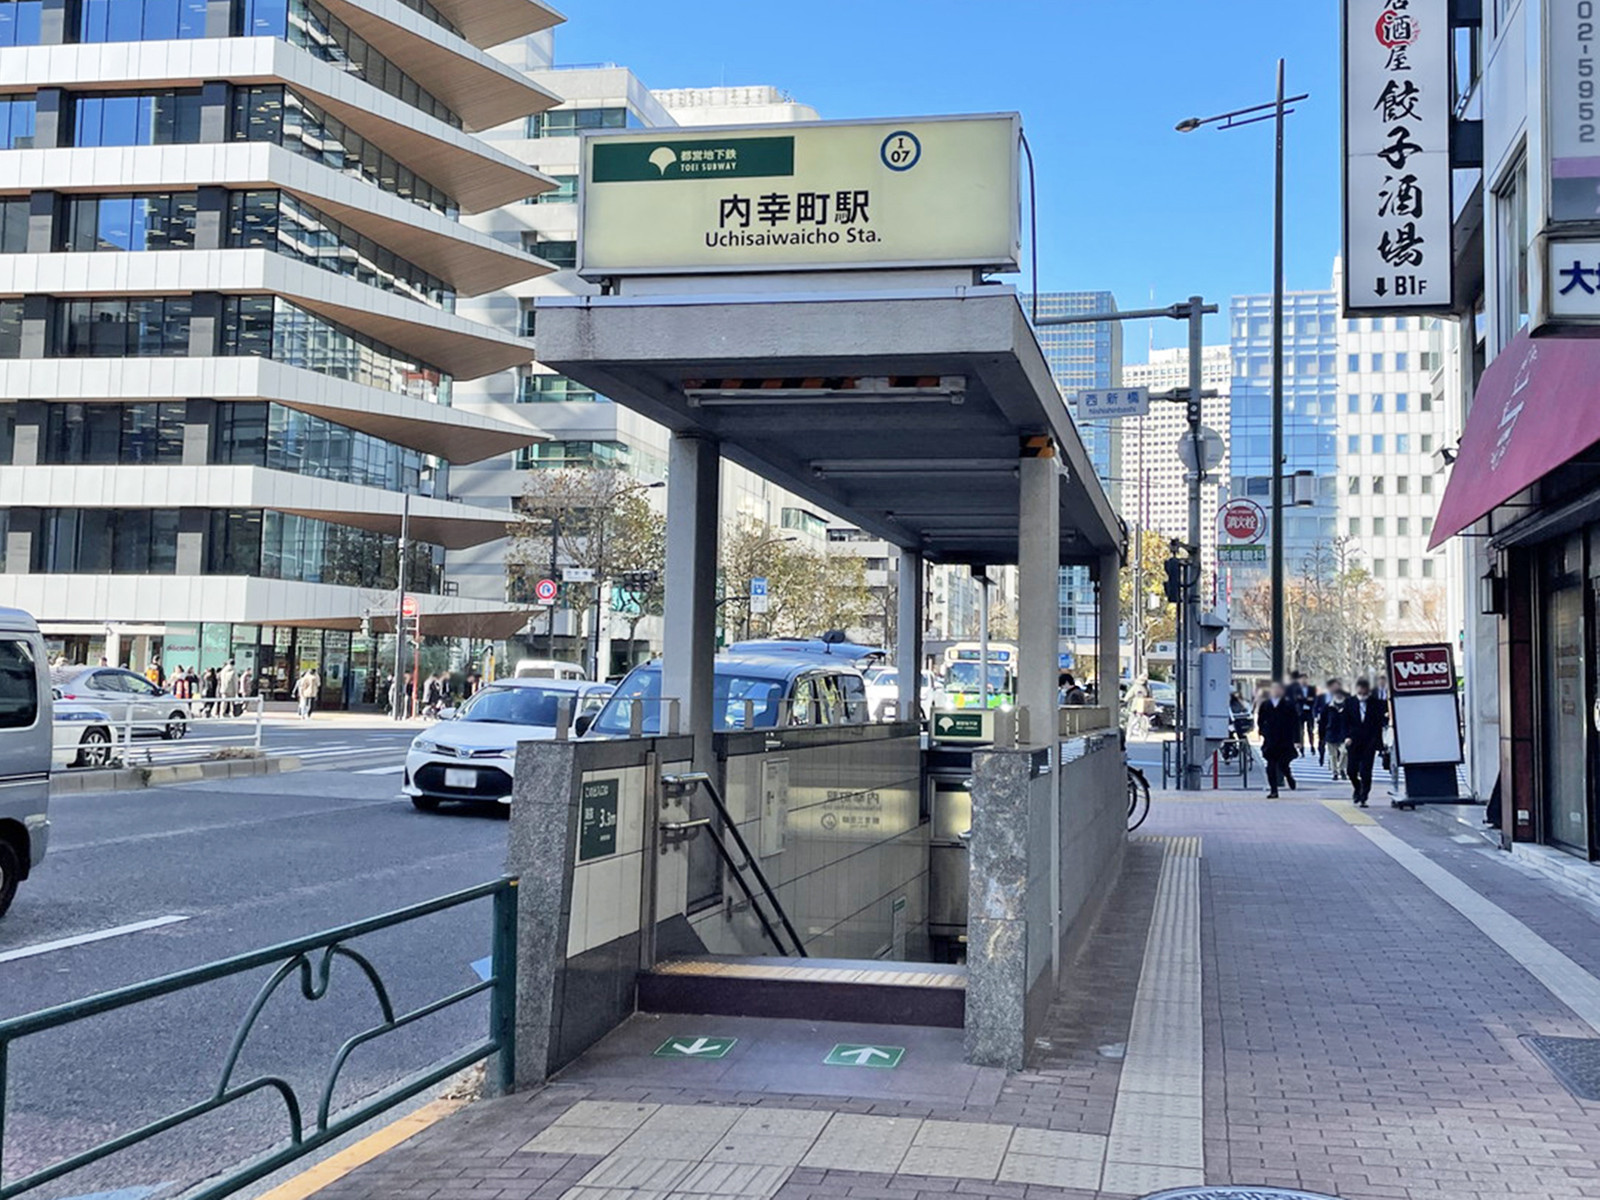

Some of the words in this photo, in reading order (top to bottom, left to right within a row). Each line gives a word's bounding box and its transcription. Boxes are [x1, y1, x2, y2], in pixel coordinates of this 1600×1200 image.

[681, 149, 737, 161] 都営地下鉄
[890, 150, 911, 163] 07
[681, 163, 699, 171] TOEI
[701, 162, 736, 171] SUBWAY
[1373, 79, 1424, 267] 餃子酒場
[719, 190, 870, 229] 内幸町駅
[705, 228, 840, 247] Uchisaiwaicho
[846, 227, 881, 244] Sta.
[1395, 275, 1427, 296] B1F
[1558, 260, 1600, 296] 大
[1086, 391, 1139, 406] 西新橋
[1227, 515, 1256, 530] 消火栓
[1394, 661, 1448, 679] VOLKS
